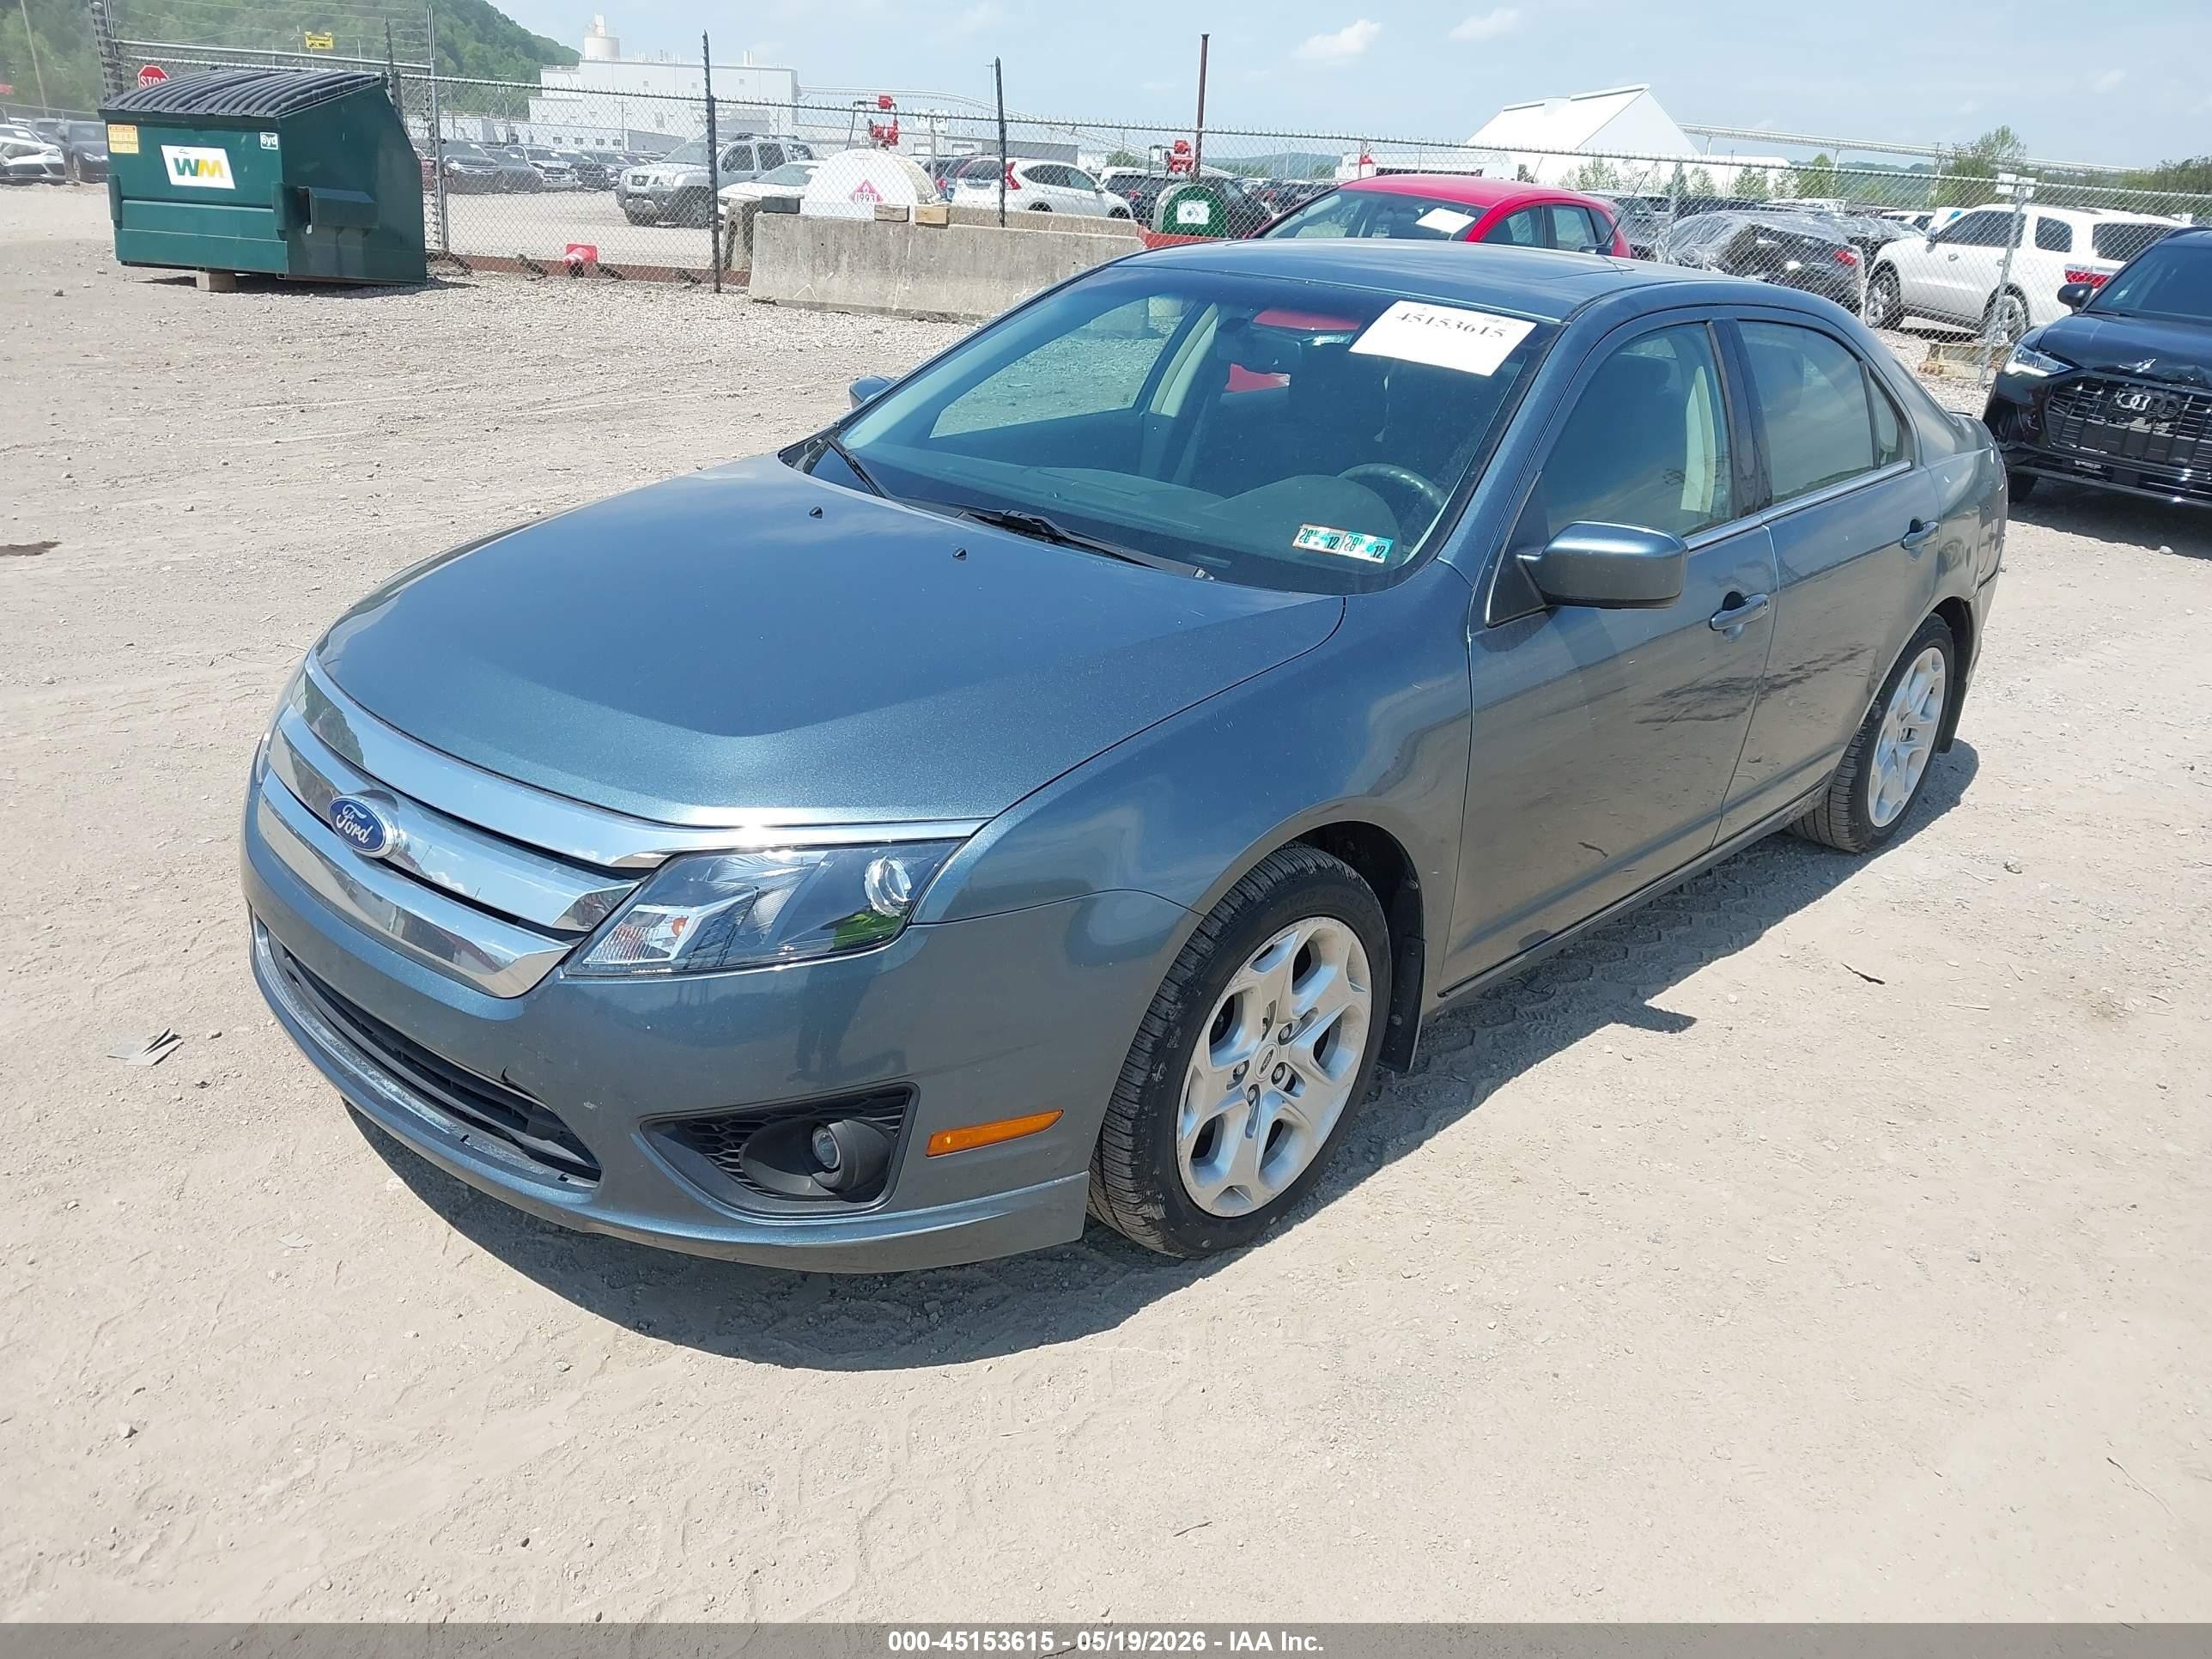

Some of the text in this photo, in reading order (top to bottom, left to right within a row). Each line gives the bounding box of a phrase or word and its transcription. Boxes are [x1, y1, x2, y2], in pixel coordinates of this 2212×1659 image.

[141, 76, 167, 88] STO
[173, 157, 225, 179] WM
[1396, 313, 1506, 337] 45153615
[1327, 536, 1340, 550] 12
[1373, 544, 1386, 559] 12
[336, 804, 374, 843] Ford
